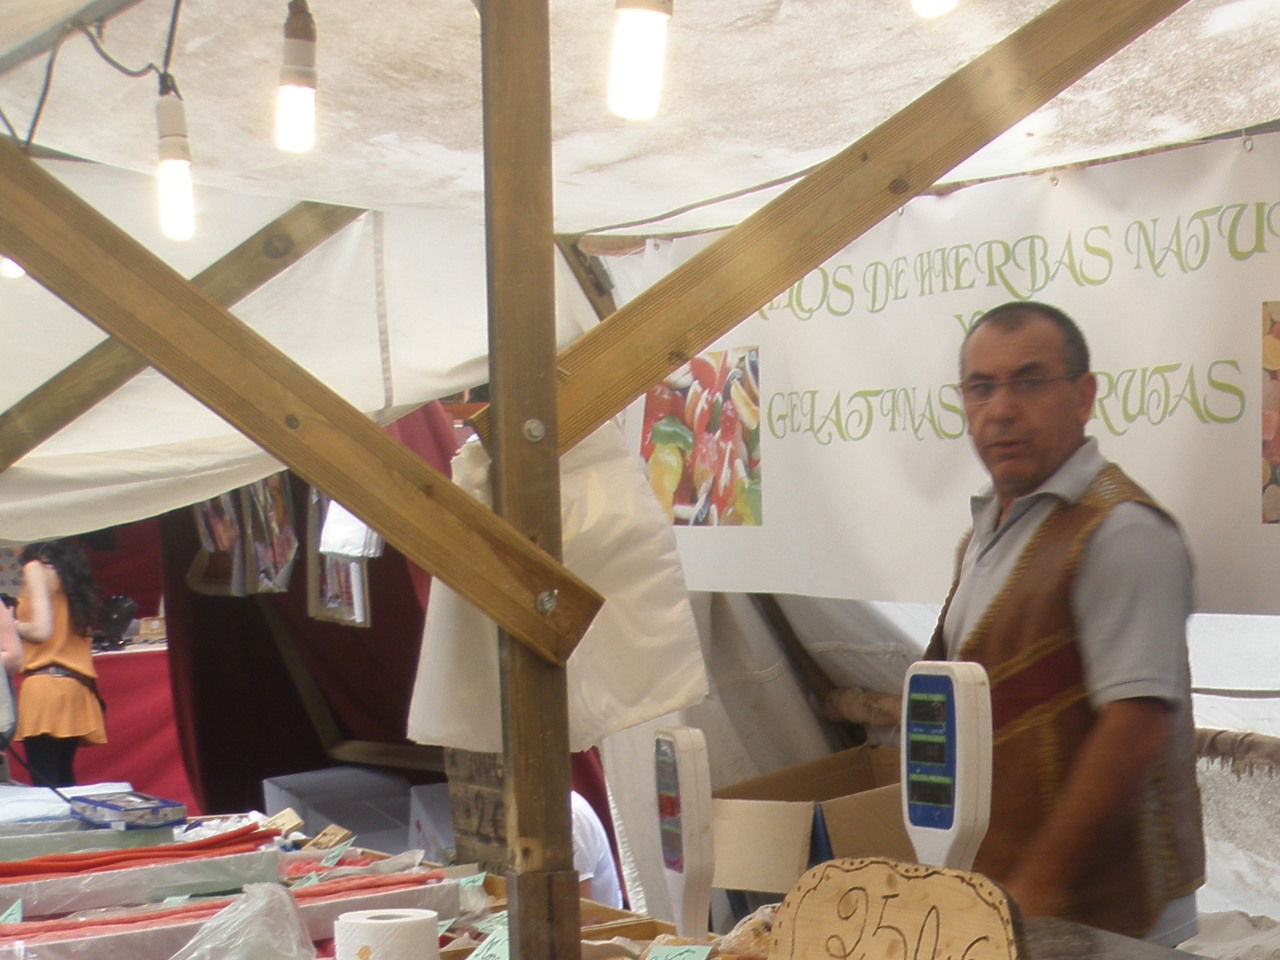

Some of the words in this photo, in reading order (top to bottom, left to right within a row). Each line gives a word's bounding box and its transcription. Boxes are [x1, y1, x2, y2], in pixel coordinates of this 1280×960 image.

[863, 256, 908, 313] DE
[913, 225, 1113, 300] HIERBAS
[767, 383, 965, 446] GELATINAS
